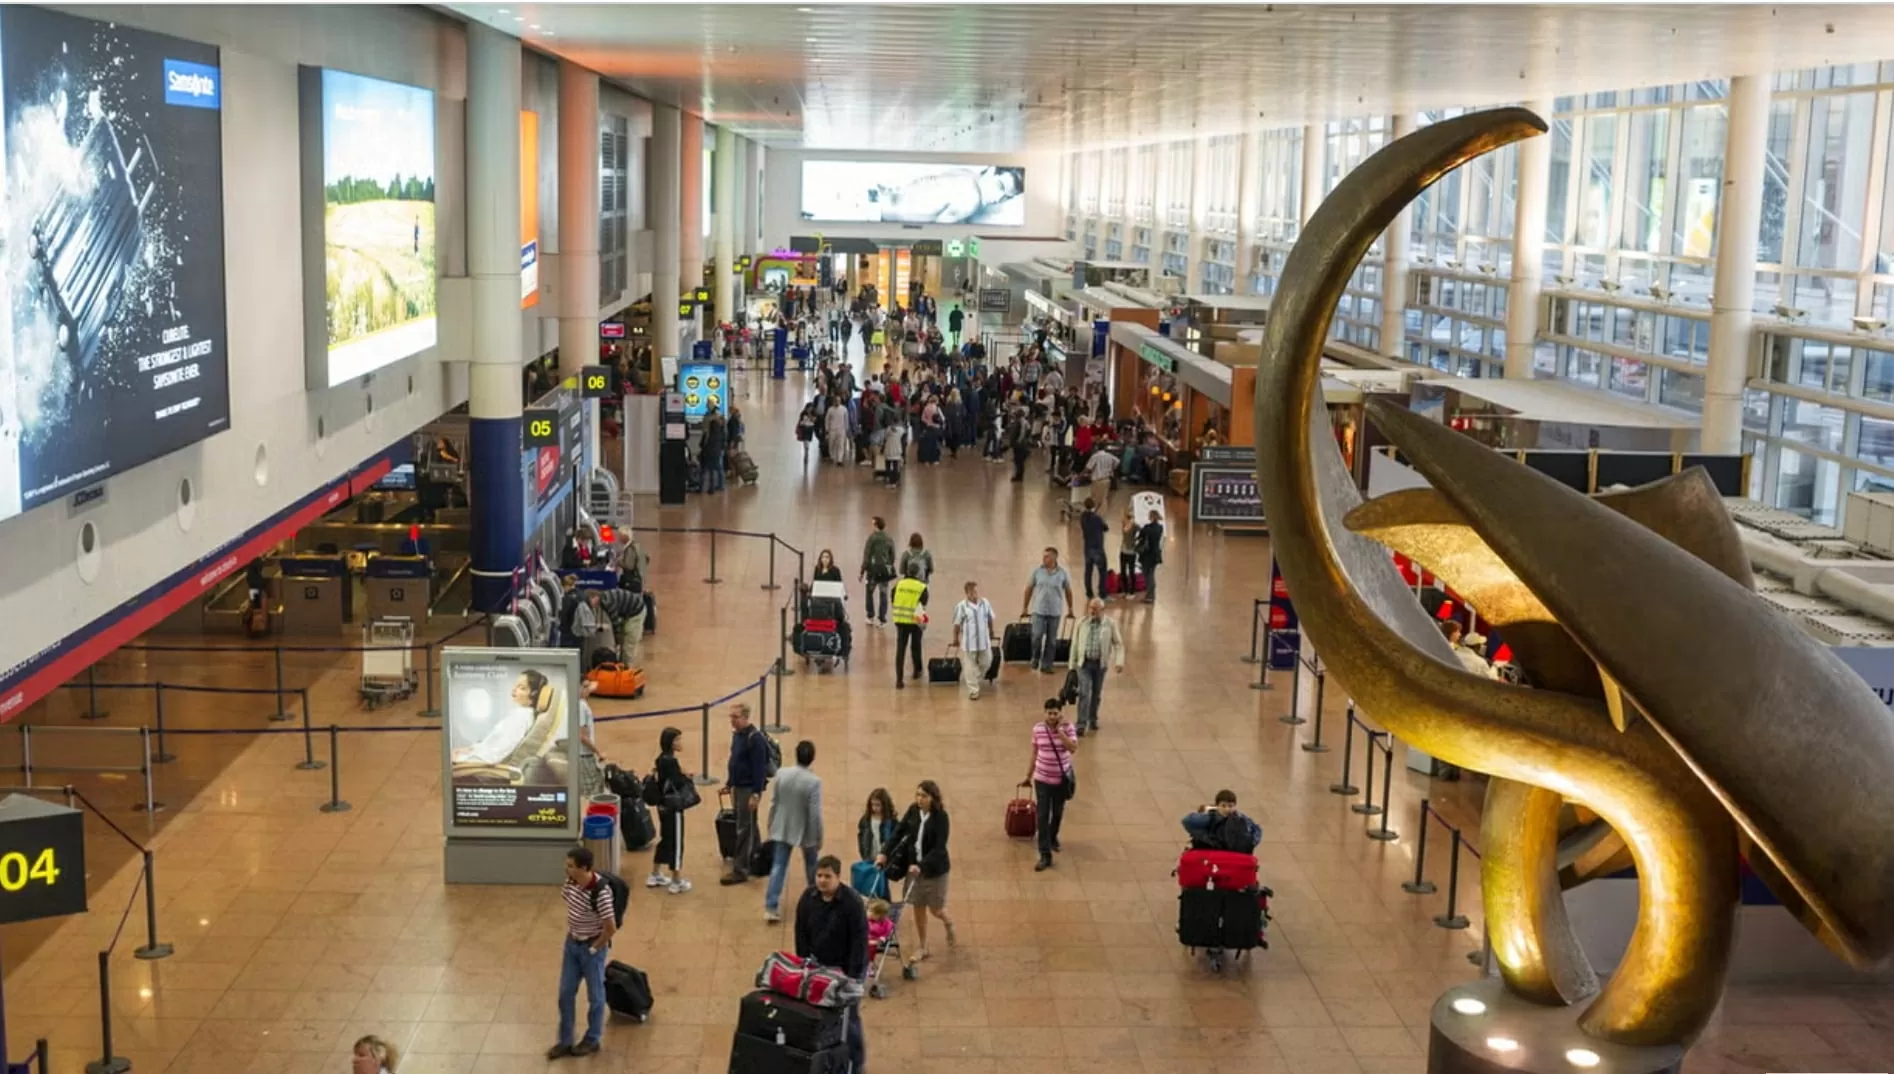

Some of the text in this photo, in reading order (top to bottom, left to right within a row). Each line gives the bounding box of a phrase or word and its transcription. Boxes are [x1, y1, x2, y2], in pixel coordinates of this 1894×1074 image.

[587, 376, 605, 389] 06
[530, 420, 551, 437] 05
[0, 847, 60, 892] 04
